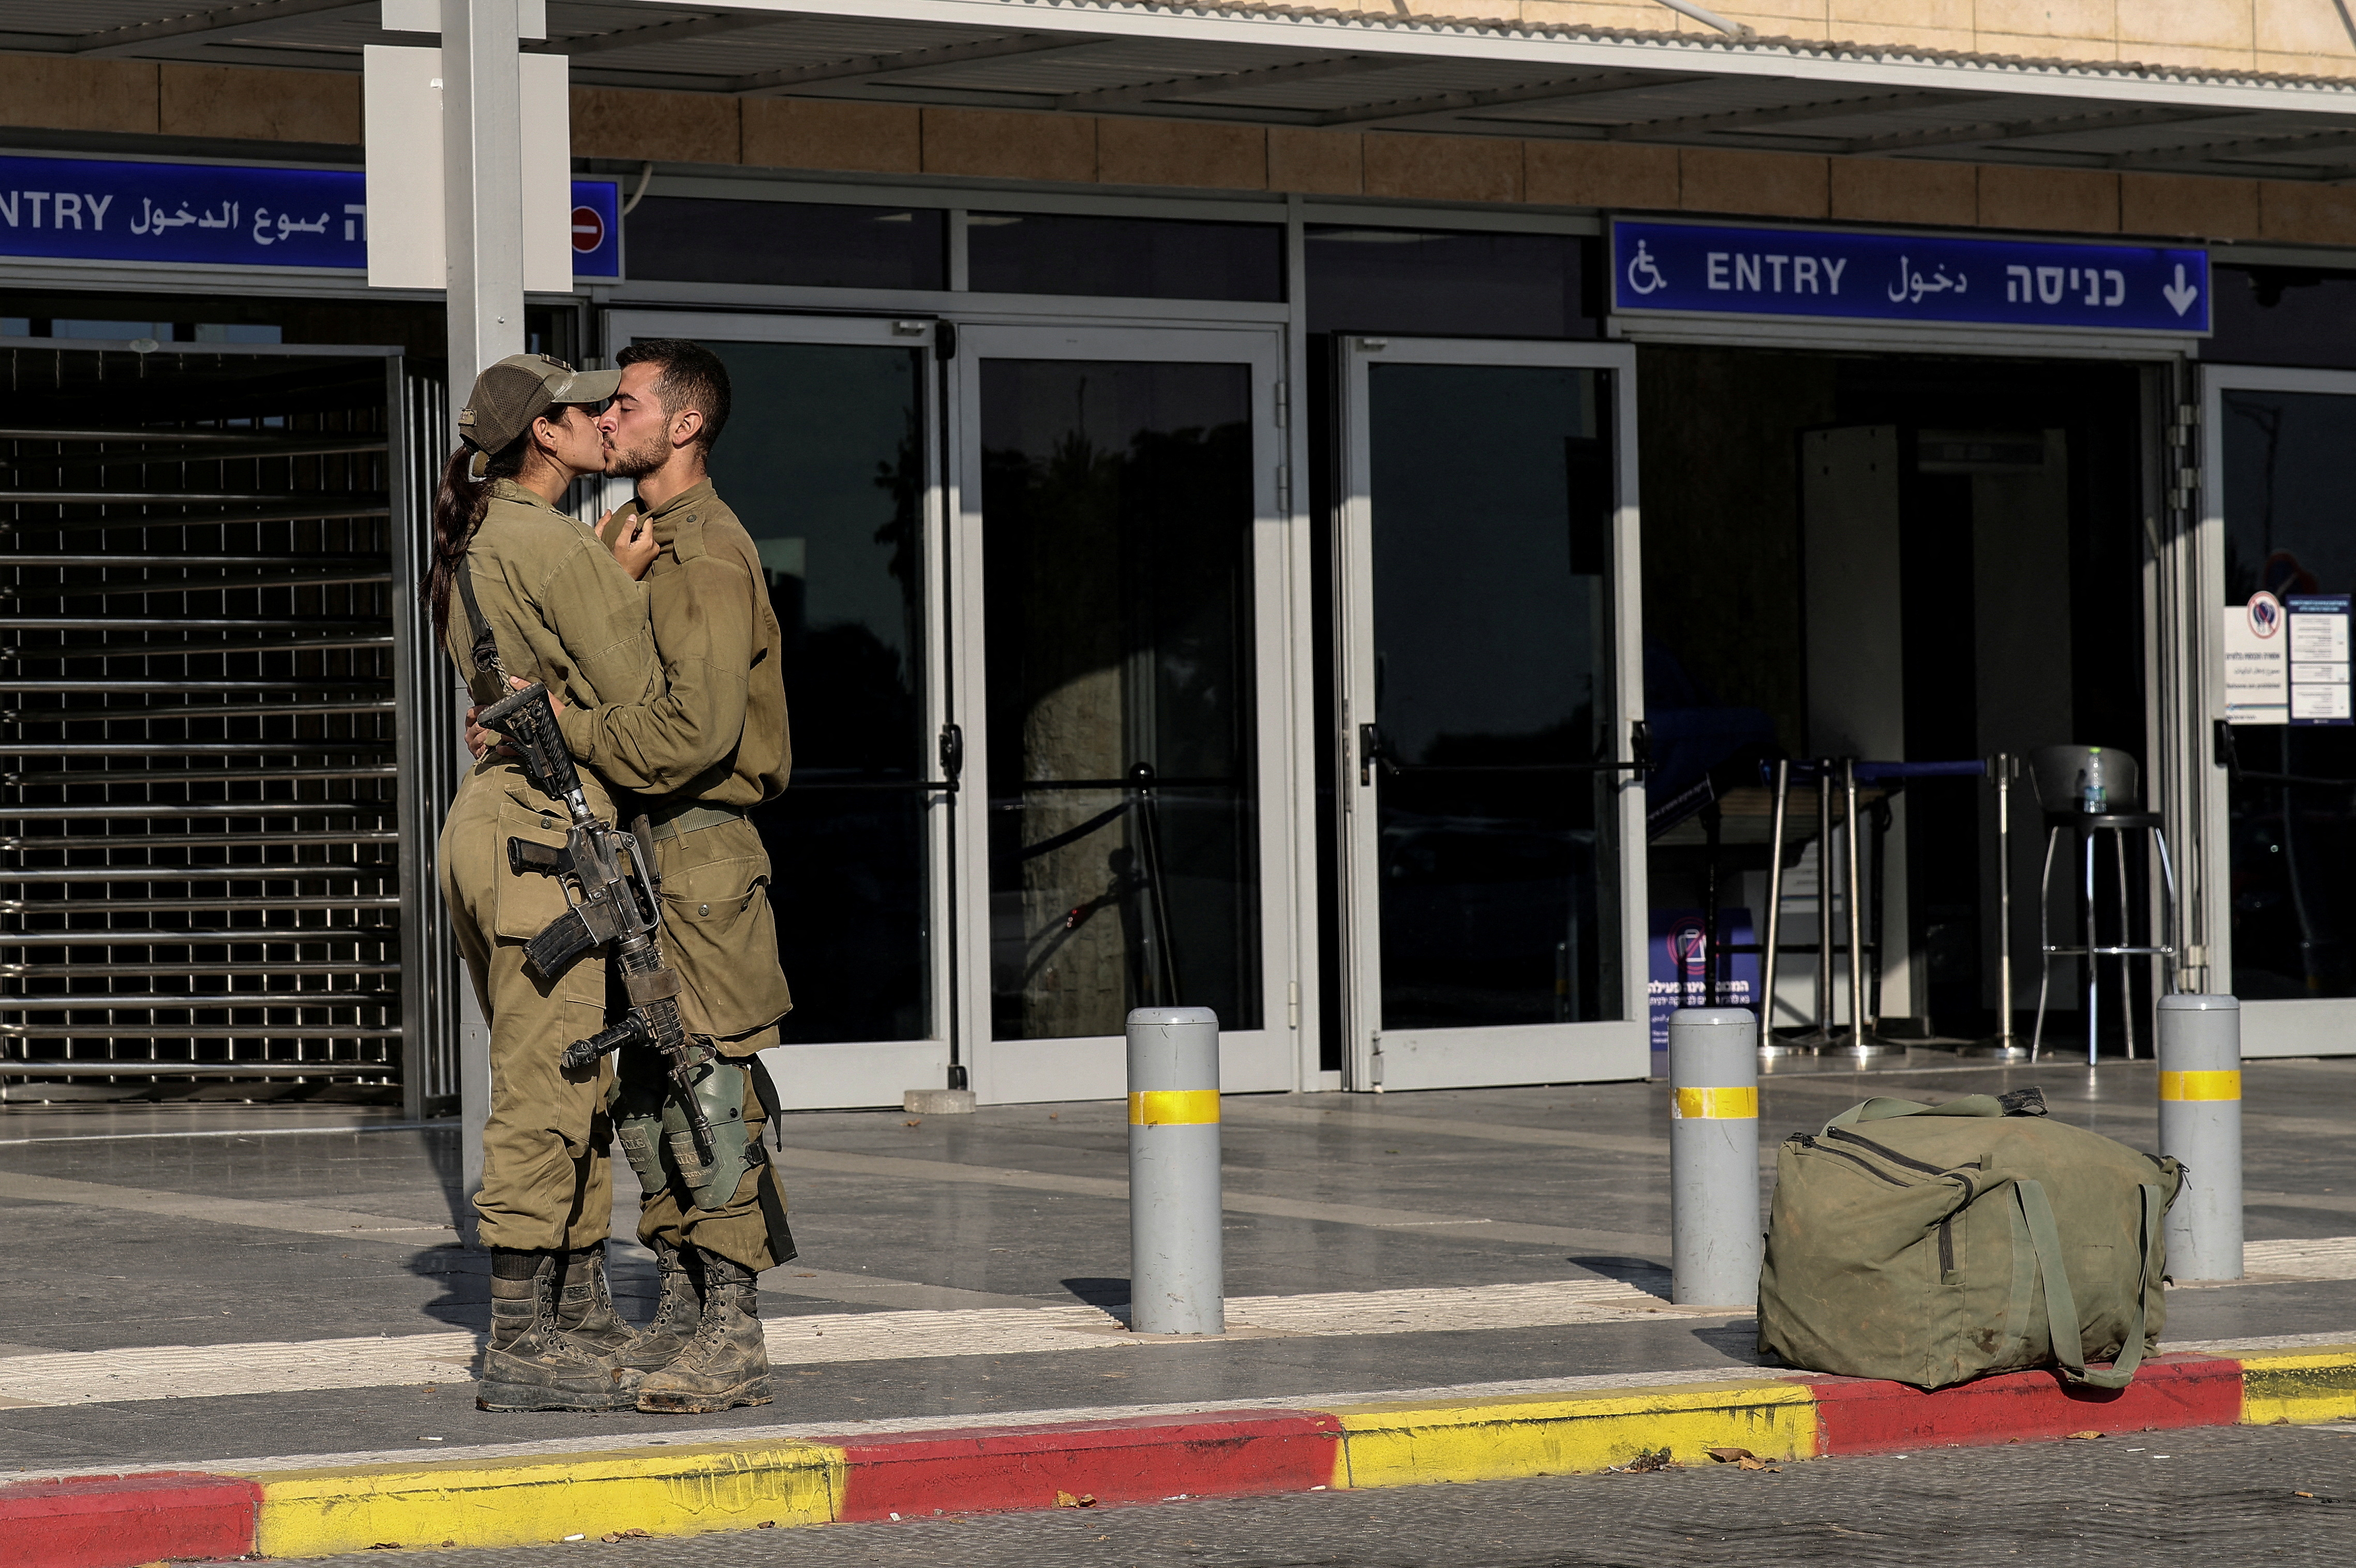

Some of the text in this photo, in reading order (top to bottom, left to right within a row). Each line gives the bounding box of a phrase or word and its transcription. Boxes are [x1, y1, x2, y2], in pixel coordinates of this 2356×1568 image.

[130, 197, 239, 235] الدخول
[1707, 251, 1847, 295] ENTRY
[1887, 255, 1967, 304] دخول
[2006, 264, 2125, 307] כניסה
